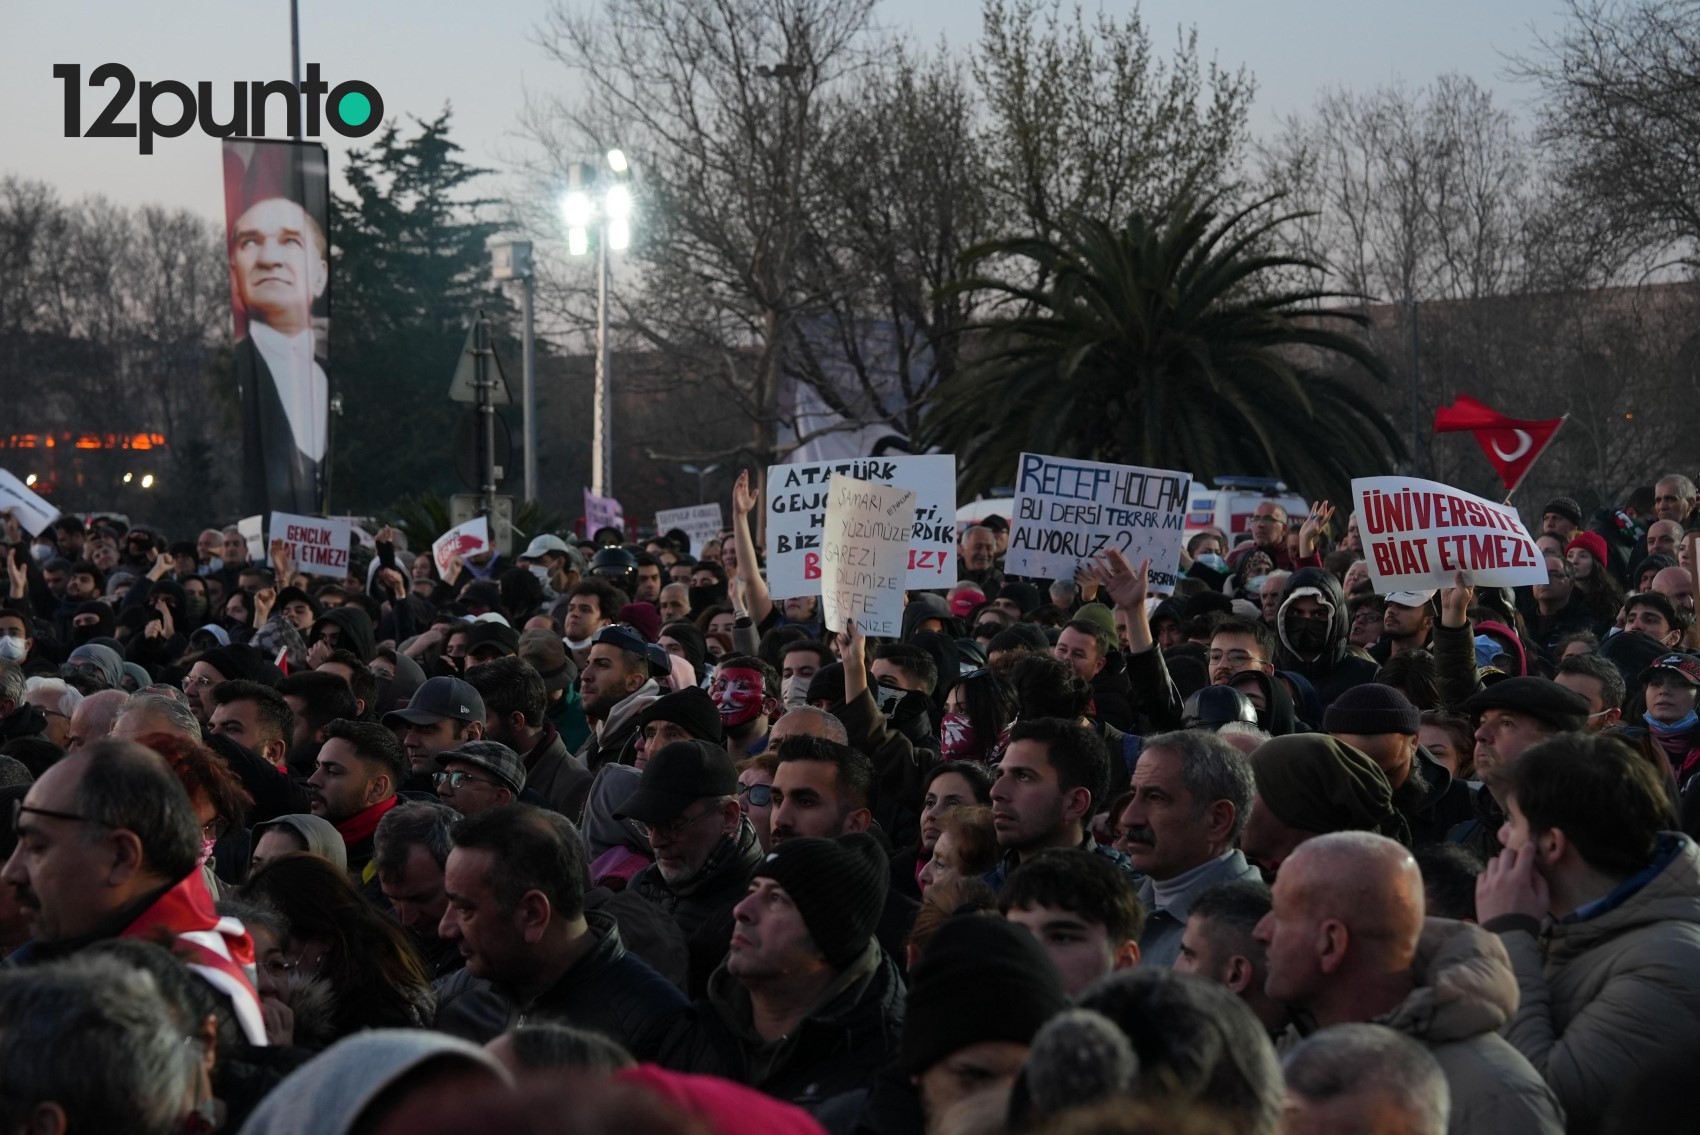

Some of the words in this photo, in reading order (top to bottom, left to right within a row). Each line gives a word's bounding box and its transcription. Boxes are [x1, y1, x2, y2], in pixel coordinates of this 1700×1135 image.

[784, 461, 897, 488] ATATÜRK
[1020, 454, 1110, 501] RECEP
[1113, 471, 1190, 514] HOCAM
[1020, 498, 1042, 520] BU
[1105, 507, 1159, 528] TEKRAR
[1362, 487, 1525, 536] ÜNİVERSİTE
[776, 531, 820, 554] BİZ
[841, 517, 911, 542] YÜZÜMÜZE
[302, 545, 347, 568] ETMEZ!
[1372, 536, 1431, 576] BİAT
[1437, 534, 1537, 572] ETMEZ!
